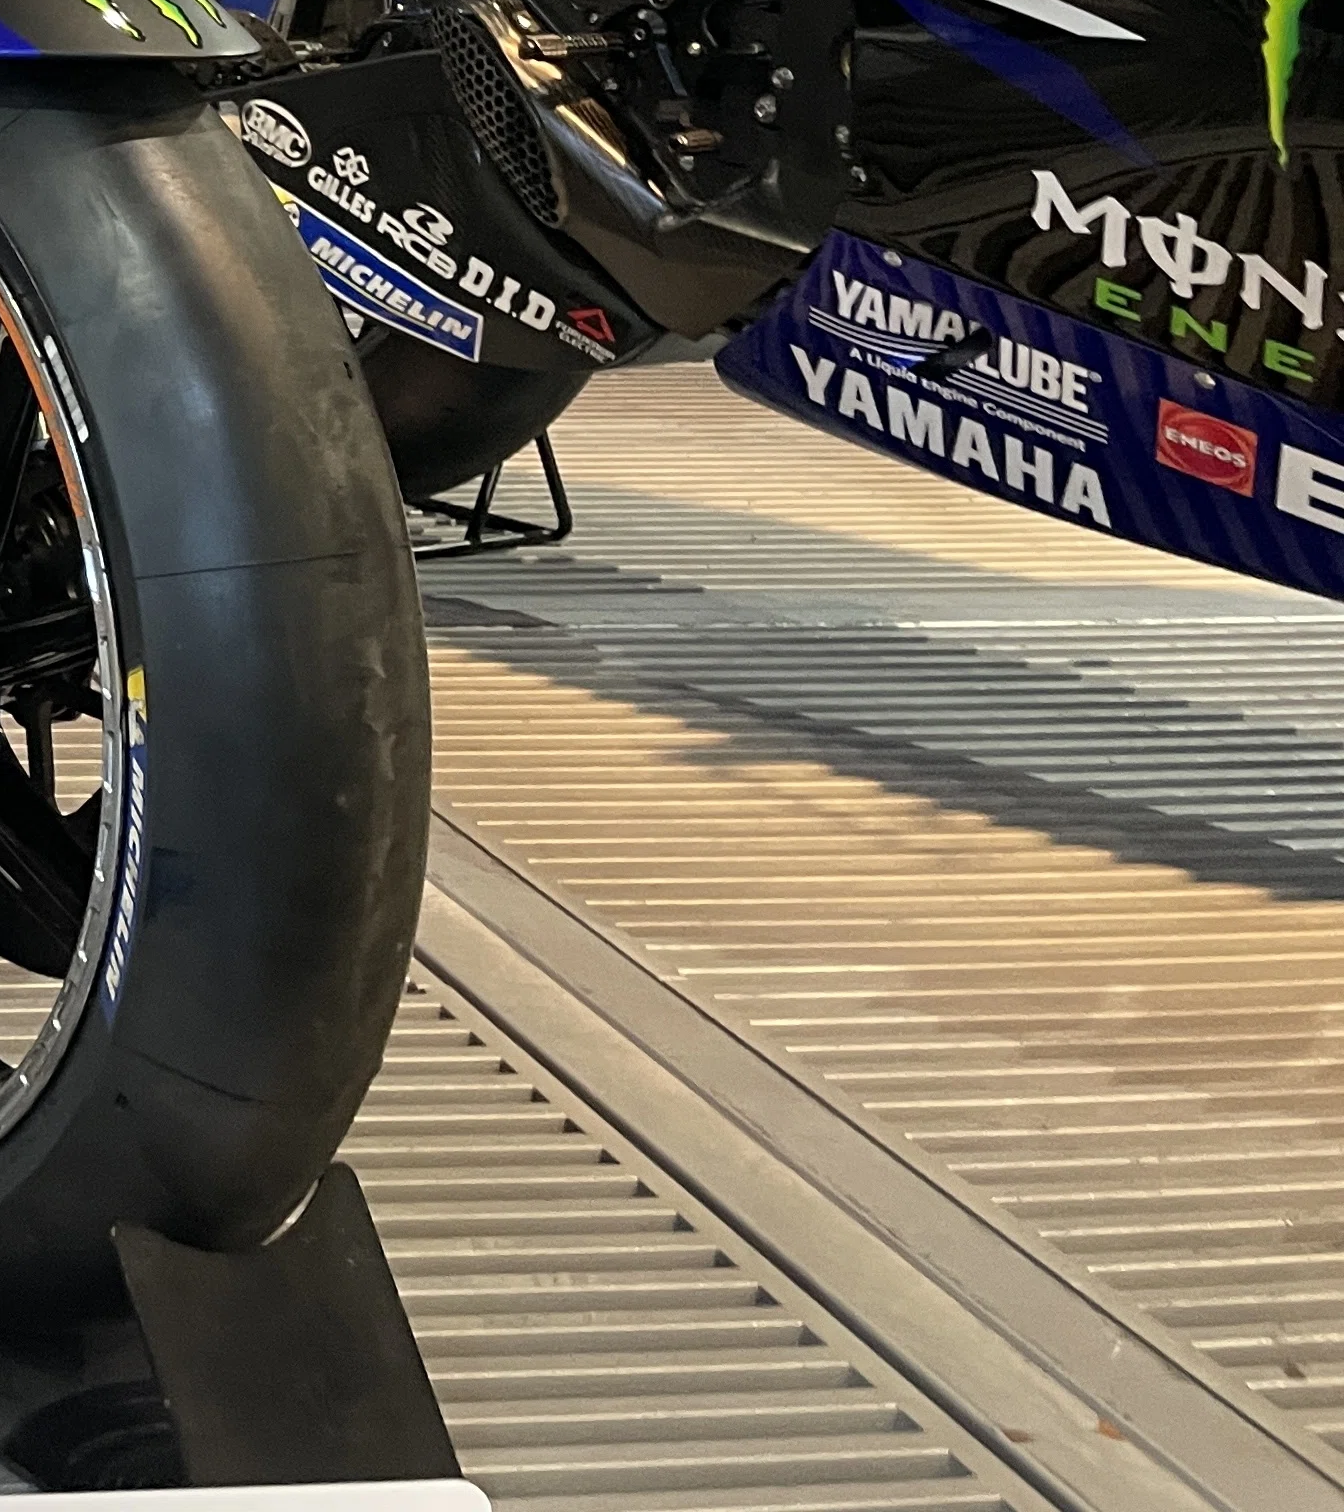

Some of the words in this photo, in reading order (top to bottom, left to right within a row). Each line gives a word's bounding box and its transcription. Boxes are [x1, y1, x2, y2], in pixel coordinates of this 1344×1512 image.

[246, 104, 307, 159] BMC
[307, 165, 376, 224] GILLES
[310, 236, 473, 341] MICHELIN
[458, 255, 556, 332] D.I.D
[1031, 169, 1344, 344] MON
[789, 342, 1112, 529] YAMAHA
[982, 401, 1088, 453] Component
[1164, 425, 1248, 469] ENEOS
[104, 756, 145, 1002] MICHELIN
